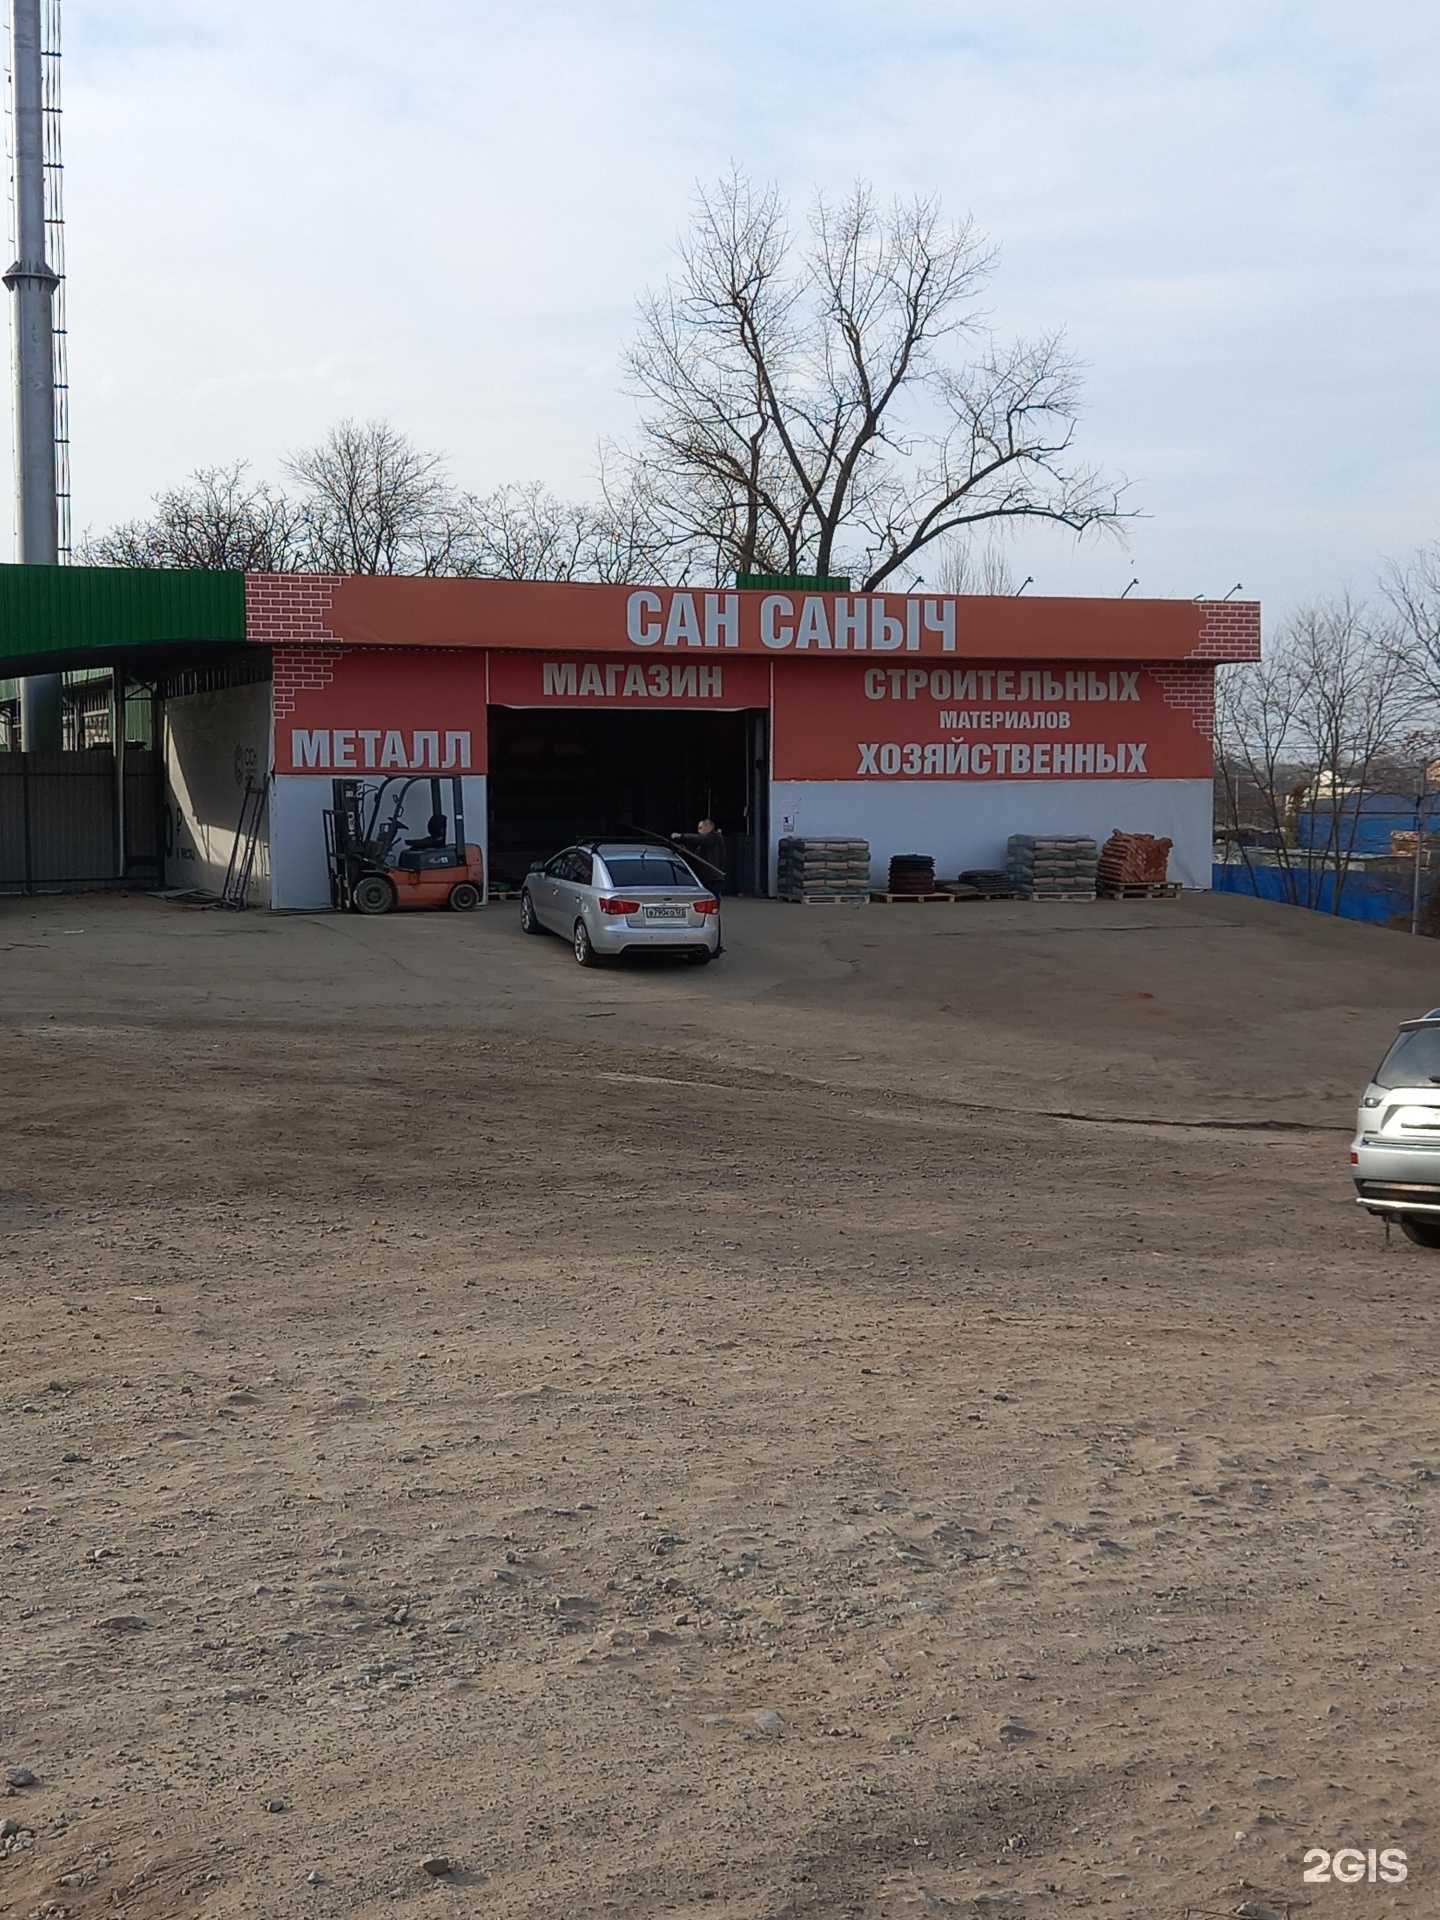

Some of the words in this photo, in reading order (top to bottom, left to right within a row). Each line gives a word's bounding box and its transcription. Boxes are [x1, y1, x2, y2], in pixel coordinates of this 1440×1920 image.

[626, 590, 740, 648] САН
[760, 594, 956, 651] САНЫЧ
[543, 662, 723, 698] МАГАЗИН
[864, 668, 1141, 701] СТРОИТЕЛЬНЫХ
[939, 710, 1071, 729] МАТЕРИАЛОВ
[291, 729, 472, 769] МЕТАЛЛ
[856, 736, 1148, 775] ХОЗЯЙСТВЕННЫХ
